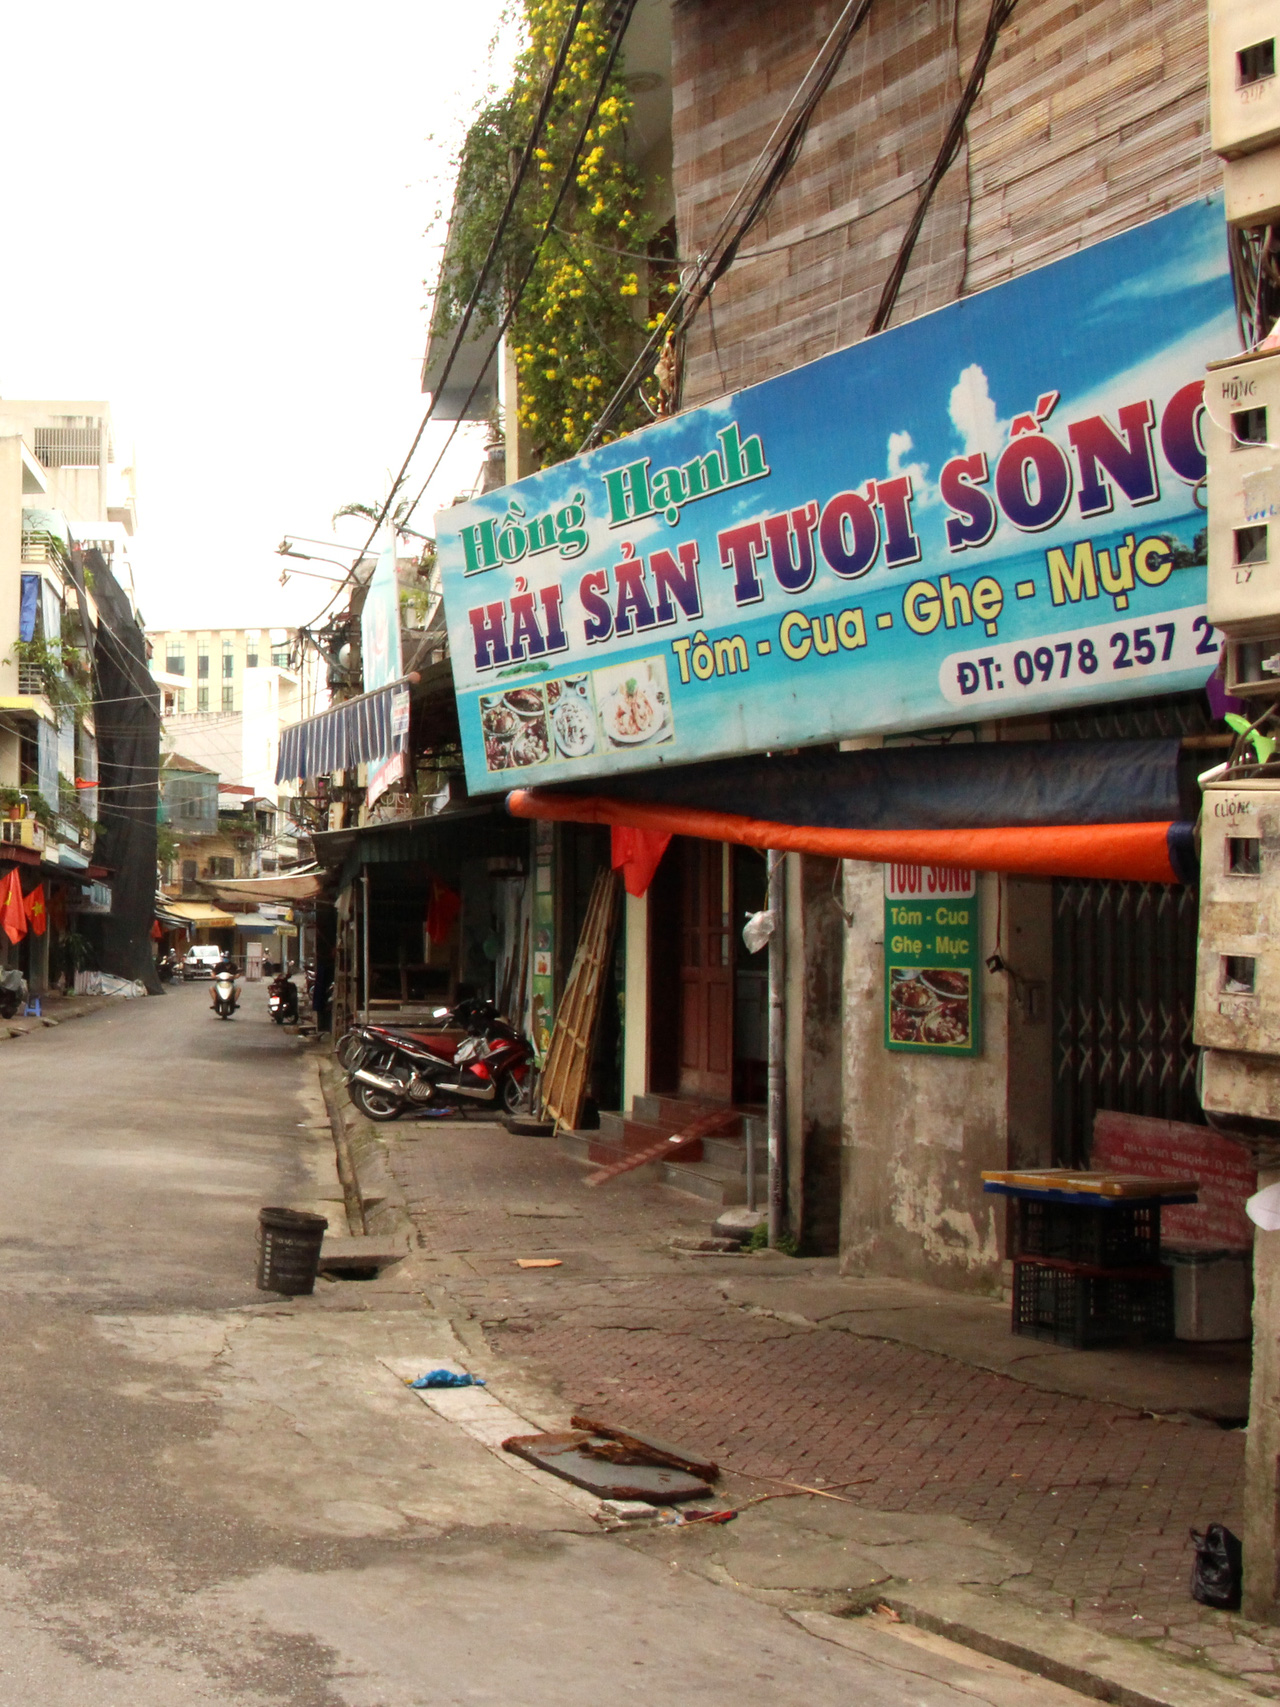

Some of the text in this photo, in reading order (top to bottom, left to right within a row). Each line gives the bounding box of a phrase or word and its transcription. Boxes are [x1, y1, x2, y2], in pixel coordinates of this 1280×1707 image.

[458, 421, 770, 577] Hồng Hạnh
[468, 575, 568, 672] HẢI
[580, 539, 703, 644] SẢN
[717, 475, 920, 607] TƯƠI
[672, 629, 749, 684] Tôm
[779, 607, 867, 661] Cua
[902, 574, 1004, 637] Ghẹ
[1046, 533, 1174, 611] Mực
[957, 615, 1224, 696] ĐT: 0978 257 2
[891, 906, 922, 926] Tôm
[935, 908, 969, 926] Cua
[891, 935, 922, 960] Ghẹ
[935, 935, 969, 960] Mực
